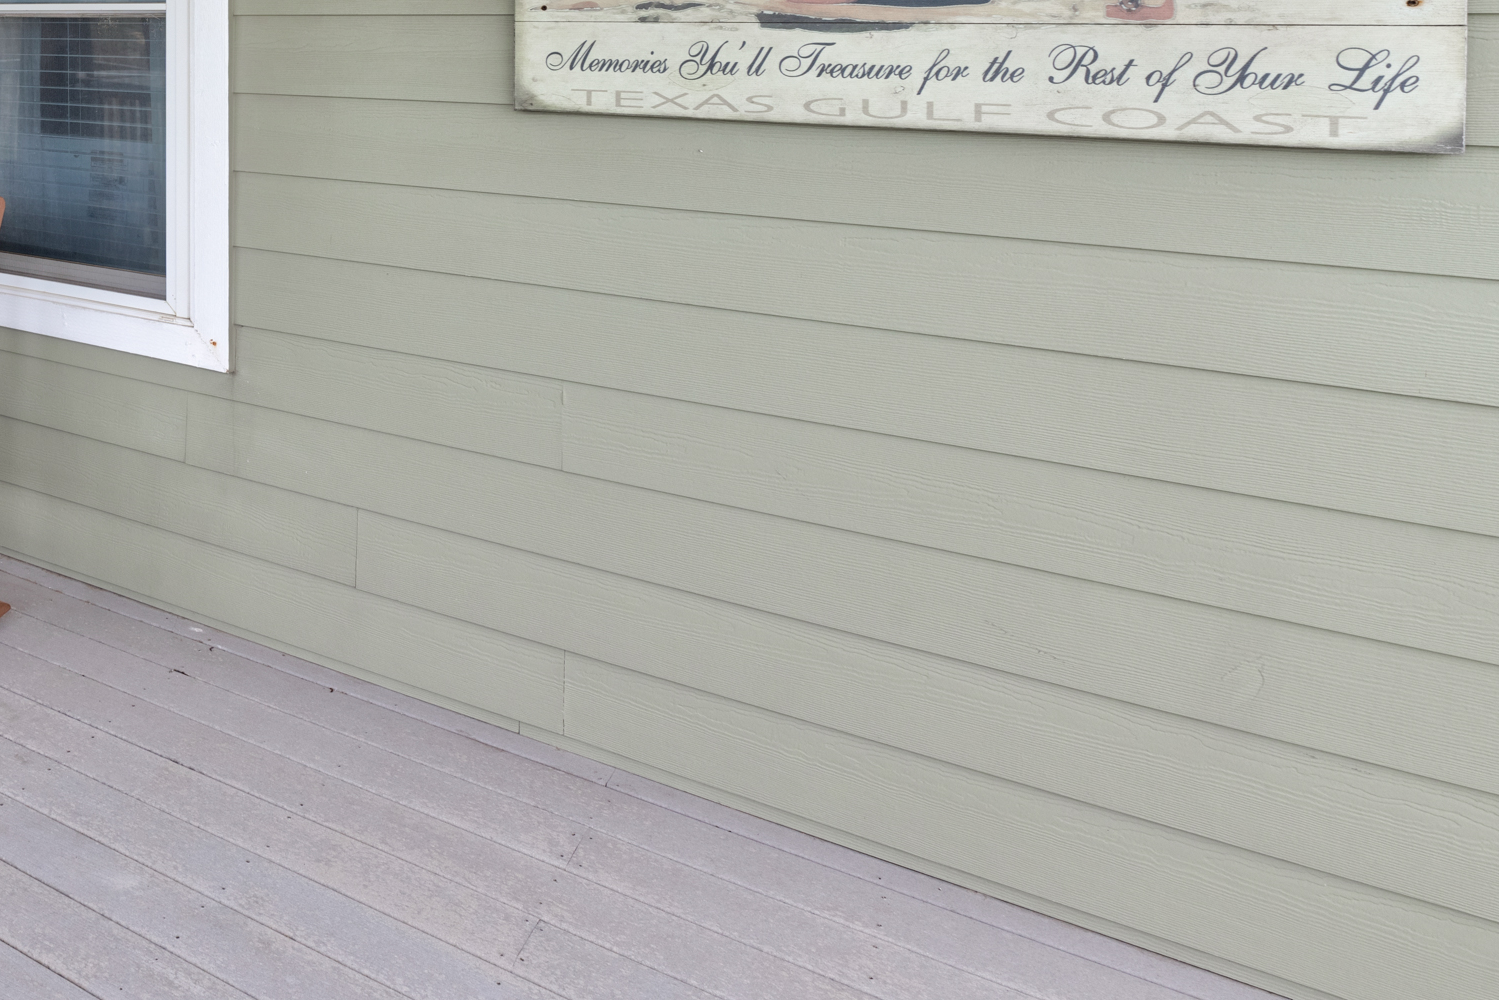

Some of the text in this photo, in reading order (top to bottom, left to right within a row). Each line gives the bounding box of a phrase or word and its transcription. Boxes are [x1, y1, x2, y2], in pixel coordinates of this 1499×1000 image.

[545, 39, 1421, 111] Memories You'll Treasure for the Rest of Your Life
[570, 88, 1369, 138] TEXAS GULF COAST
